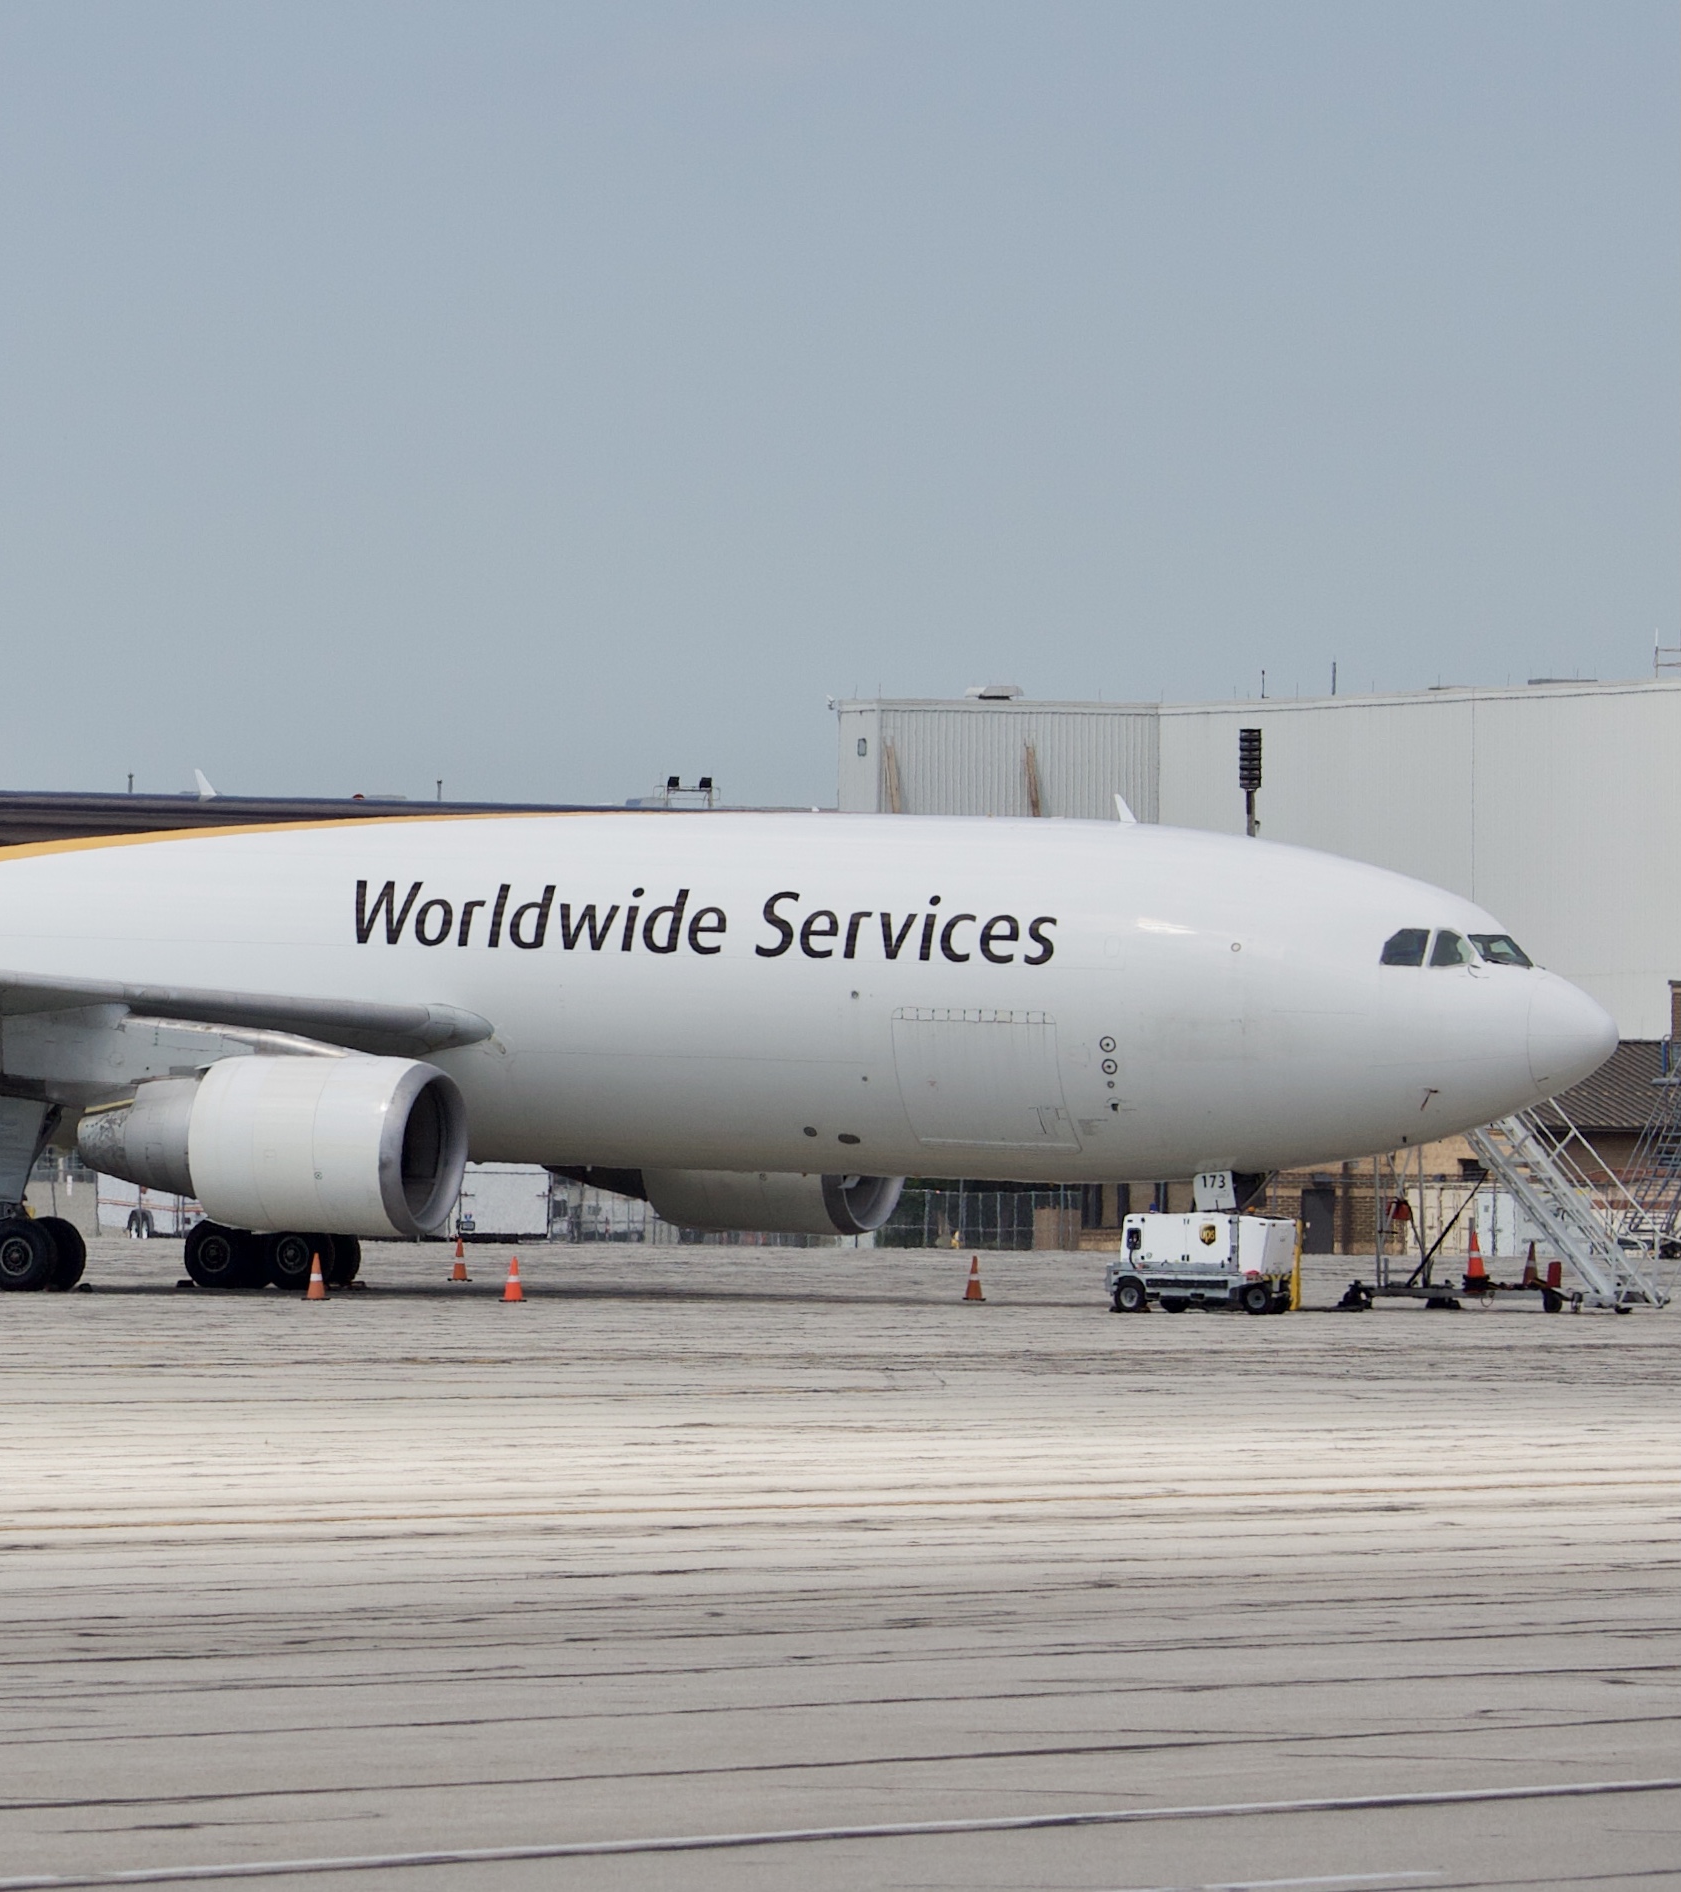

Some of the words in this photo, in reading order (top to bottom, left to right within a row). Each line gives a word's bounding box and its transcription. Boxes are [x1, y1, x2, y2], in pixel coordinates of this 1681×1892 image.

[355, 879, 727, 955] Worldwide
[755, 891, 1058, 965] Services
[1202, 1174, 1226, 1188] 173
